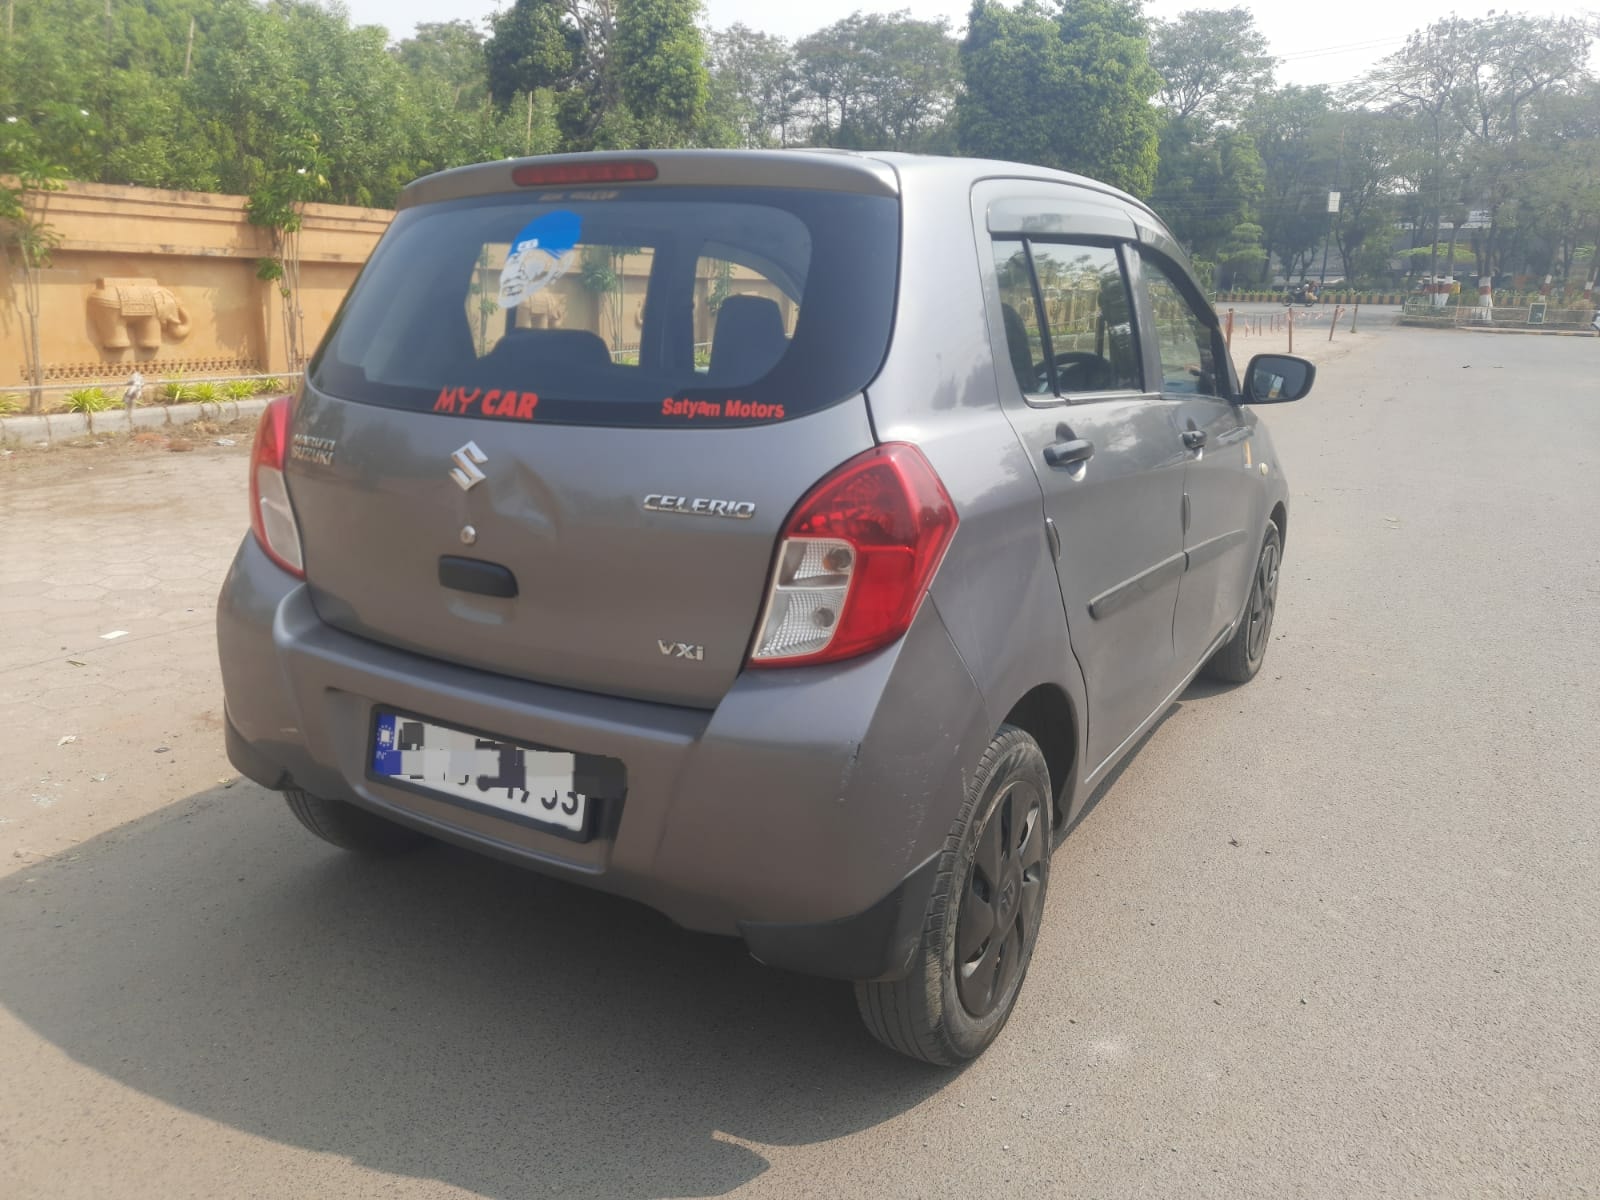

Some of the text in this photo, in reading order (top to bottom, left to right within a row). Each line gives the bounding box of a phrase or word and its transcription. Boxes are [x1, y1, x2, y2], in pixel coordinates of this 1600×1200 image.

[434, 385, 539, 419] MY CAR
[662, 398, 784, 419] Satyam Motors
[291, 445, 334, 465] SUZUKI
[643, 494, 756, 519] CELERIO
